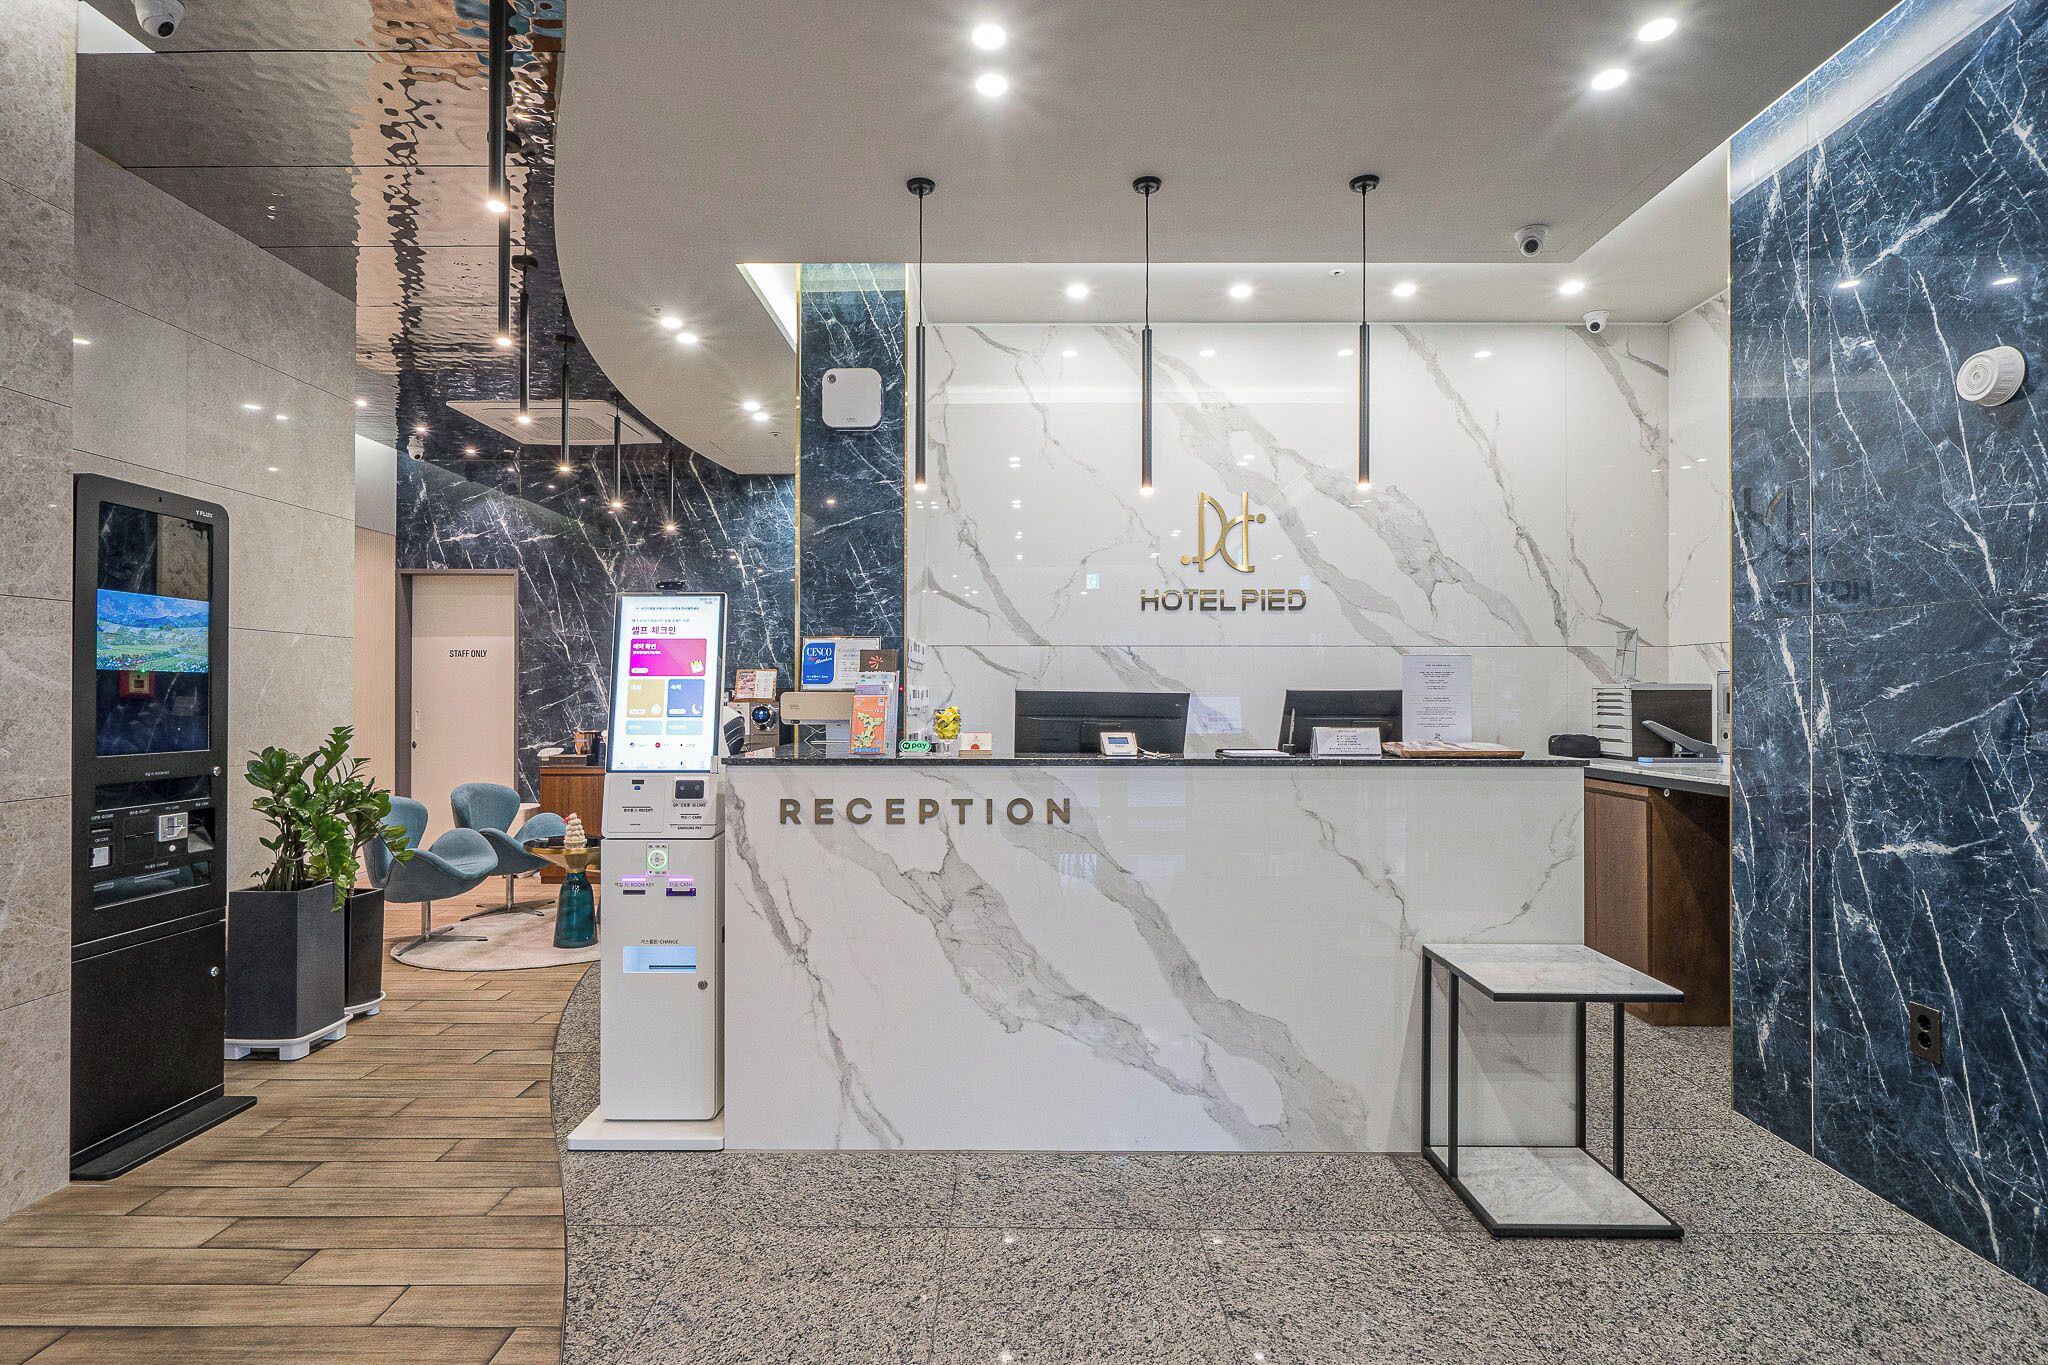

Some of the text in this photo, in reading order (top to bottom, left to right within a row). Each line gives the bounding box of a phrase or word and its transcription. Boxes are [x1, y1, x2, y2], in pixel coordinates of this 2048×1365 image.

[1140, 588, 1307, 611] HOTEL PIED
[631, 626, 648, 635] 셀프
[449, 649, 488, 658] STAFF ONLY
[806, 647, 832, 657] CESCO
[779, 797, 1072, 826] RECEPTION
